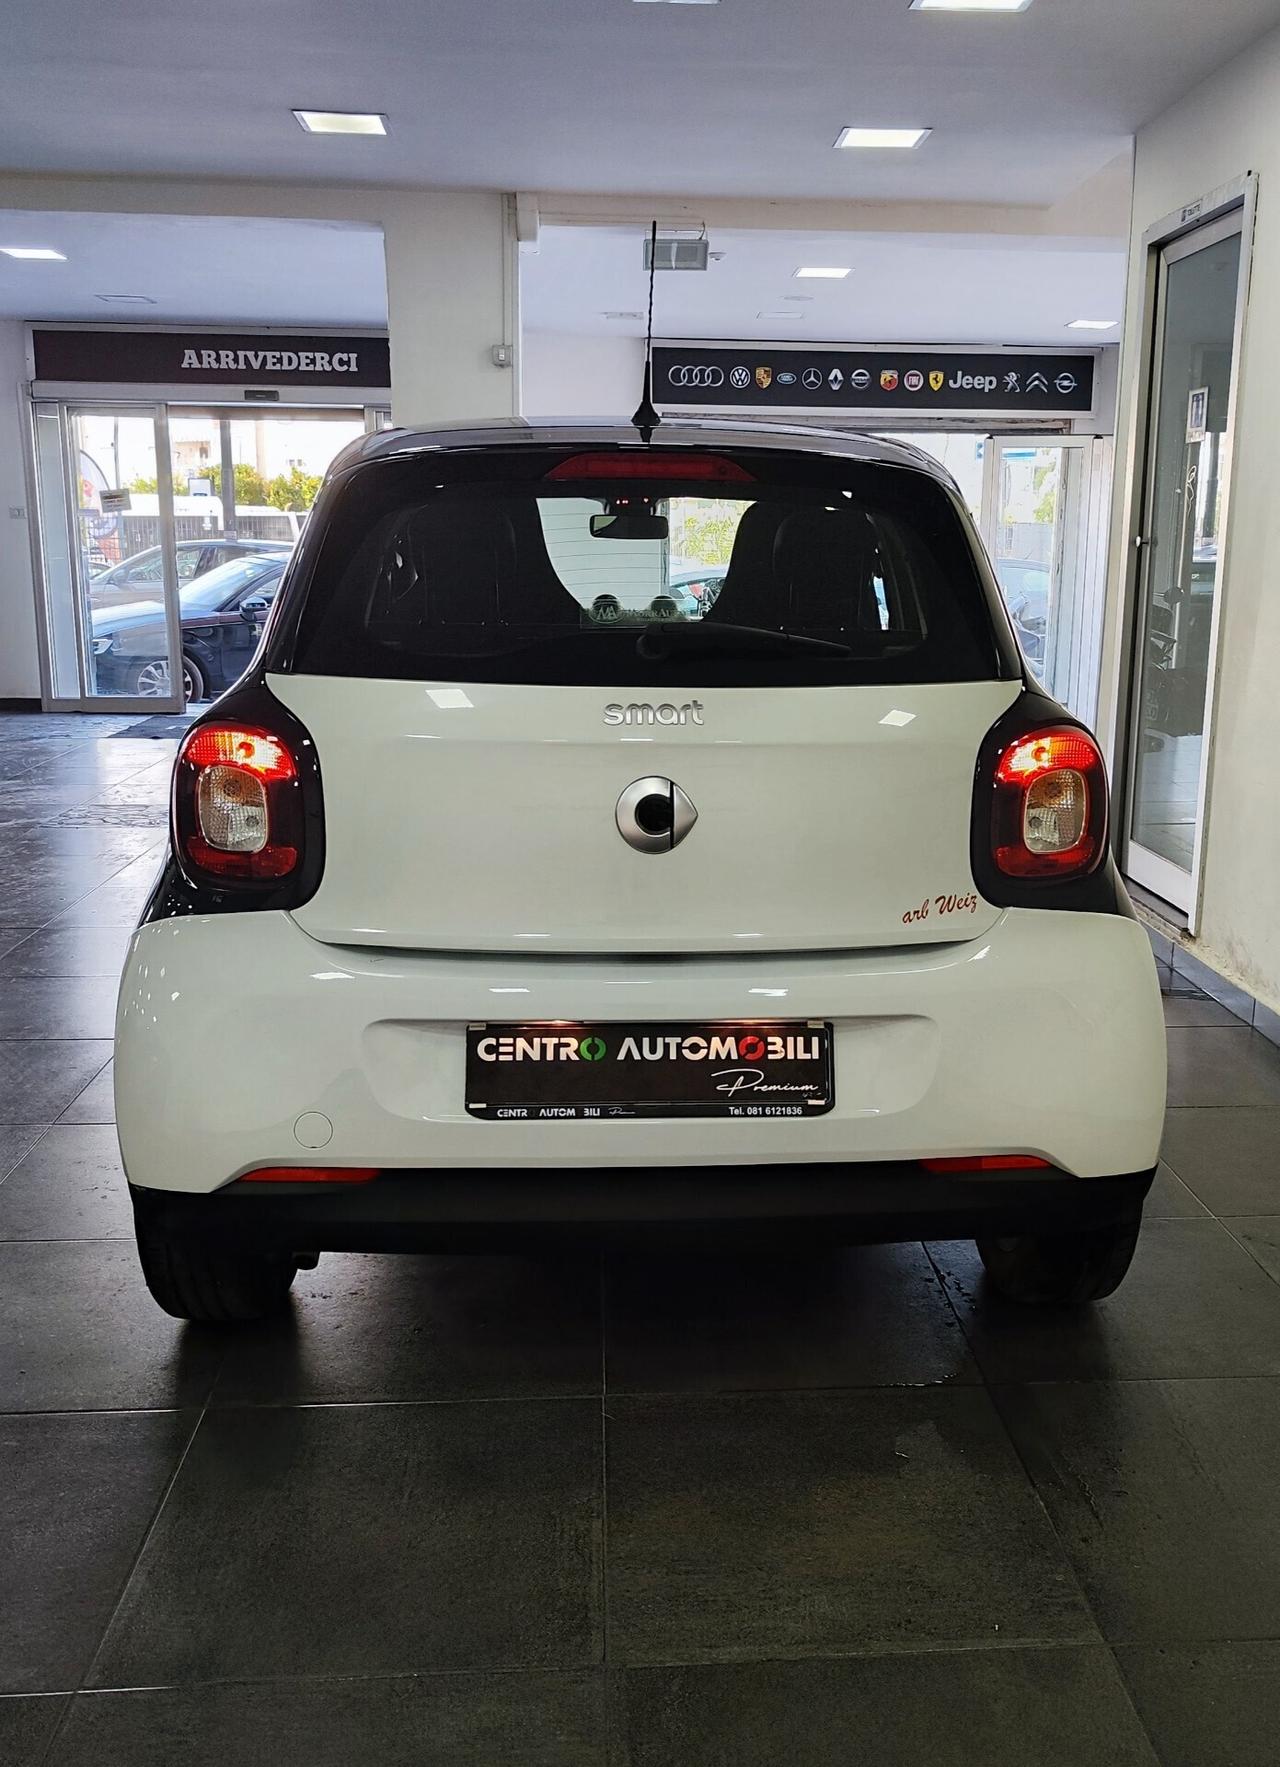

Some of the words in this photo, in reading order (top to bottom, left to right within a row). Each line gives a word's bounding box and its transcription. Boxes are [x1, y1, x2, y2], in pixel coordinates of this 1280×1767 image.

[181, 349, 358, 372] ARRIVEDERCI
[948, 371, 997, 393] Jeep
[603, 700, 704, 725] smart
[477, 1036, 606, 1062] CENTRO
[616, 1036, 820, 1061] AUTOMOBILI
[711, 1068, 819, 1097] Premium
[728, 1106, 745, 1115] Tel.
[747, 1106, 762, 1115] 081
[765, 1106, 803, 1115] 6121836
